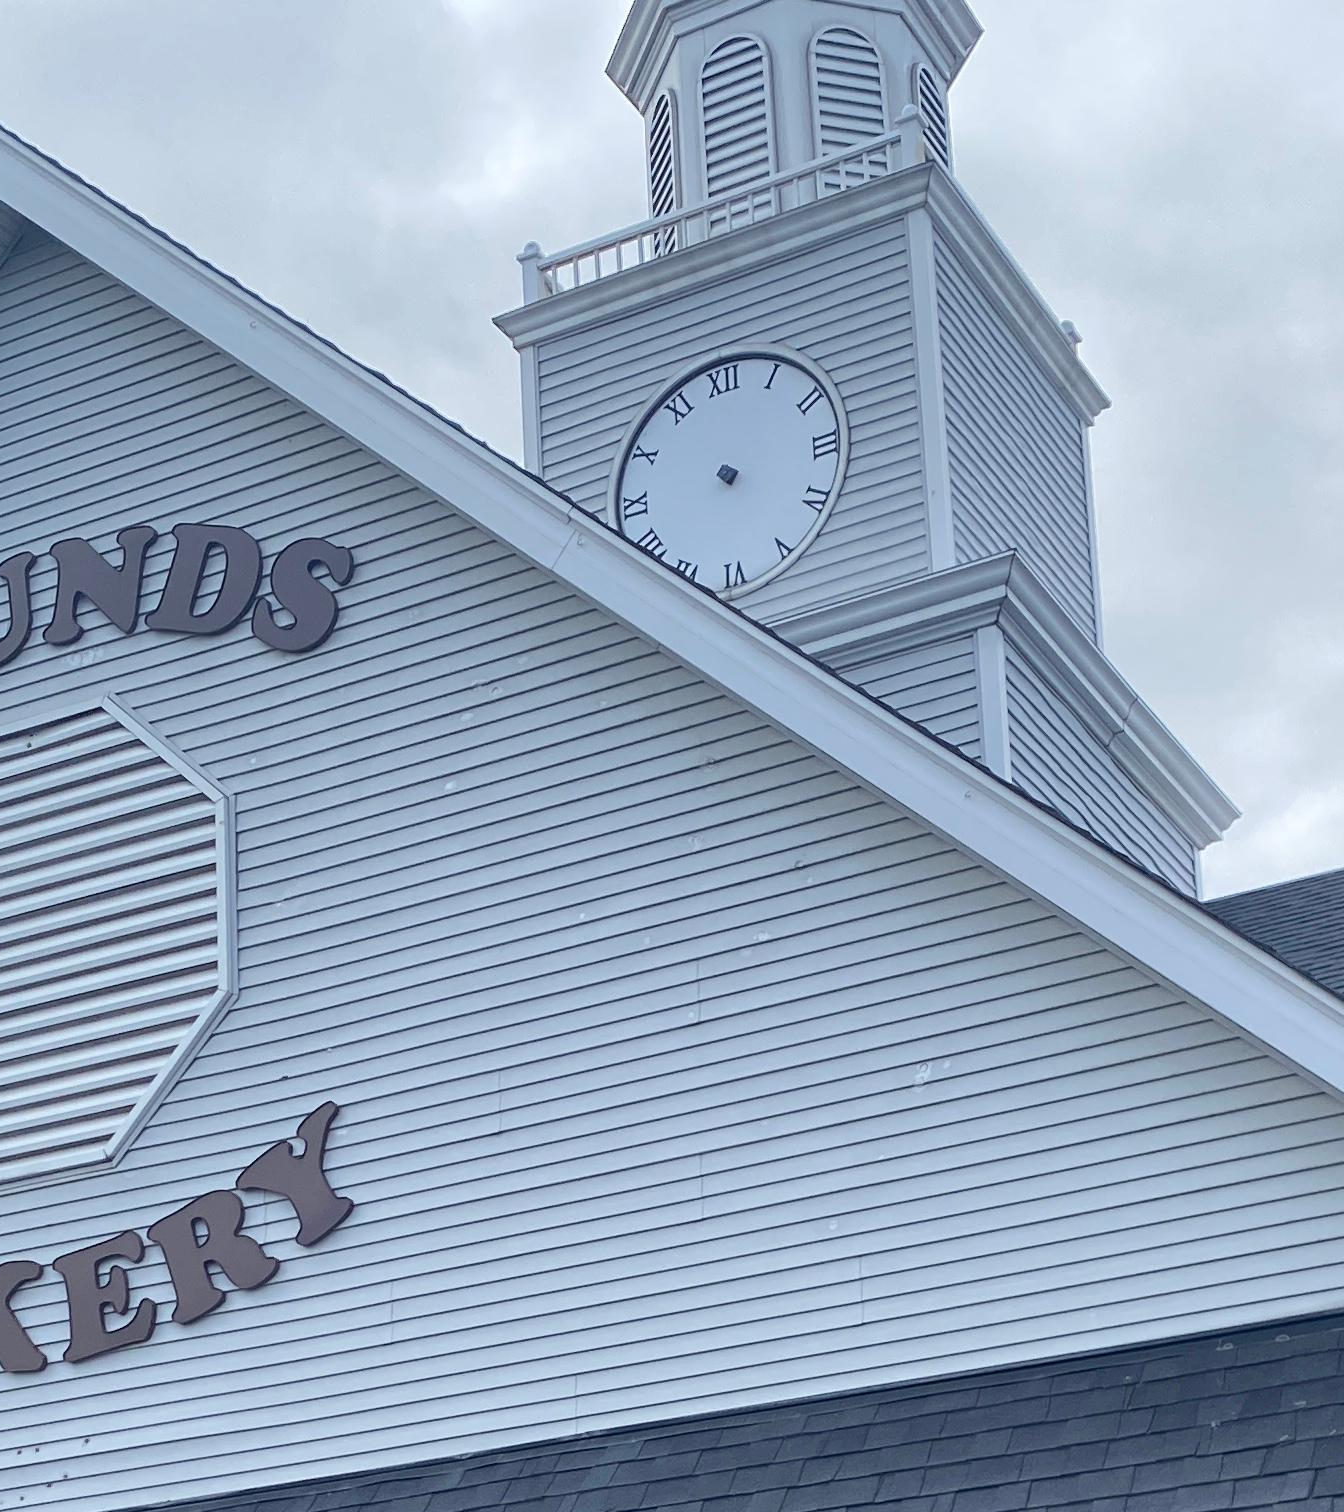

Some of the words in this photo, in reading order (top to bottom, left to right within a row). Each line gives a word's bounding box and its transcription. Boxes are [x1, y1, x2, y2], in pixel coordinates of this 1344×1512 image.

[707, 363, 740, 399] XII
[664, 391, 695, 426] XI
[796, 385, 825, 416] II
[632, 445, 659, 466] X
[812, 428, 840, 461] III
[623, 491, 648, 521] IX
[723, 560, 748, 589] VI
